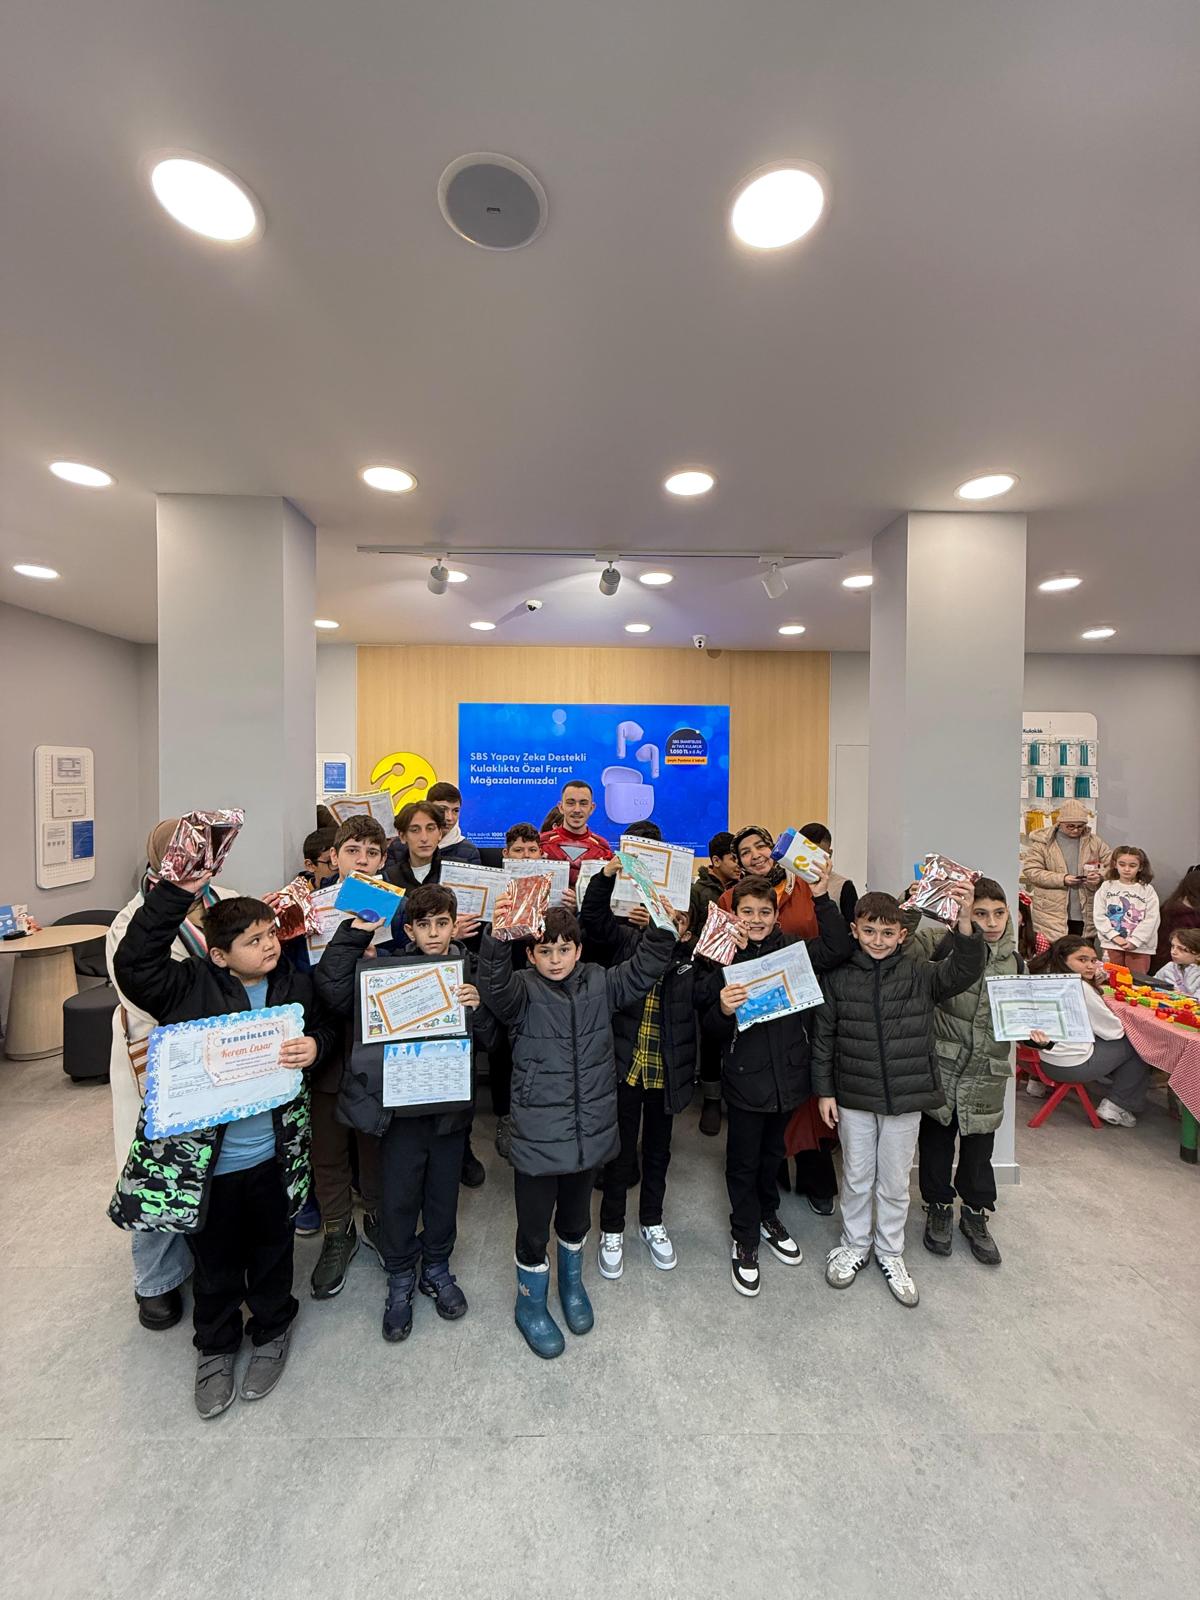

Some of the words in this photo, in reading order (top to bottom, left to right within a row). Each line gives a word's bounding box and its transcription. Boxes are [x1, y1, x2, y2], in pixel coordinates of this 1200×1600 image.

[470, 752, 488, 761] SBS
[490, 752, 521, 763] Yapay
[523, 752, 546, 762] Zeka
[548, 752, 587, 762] Destekli
[470, 764, 520, 773] Kulaklıkta
[522, 762, 544, 773] Özel
[545, 764, 573, 773] Fırsat
[470, 775, 558, 786] Mağazalarımızda!
[221, 1047, 248, 1058] Kerem
